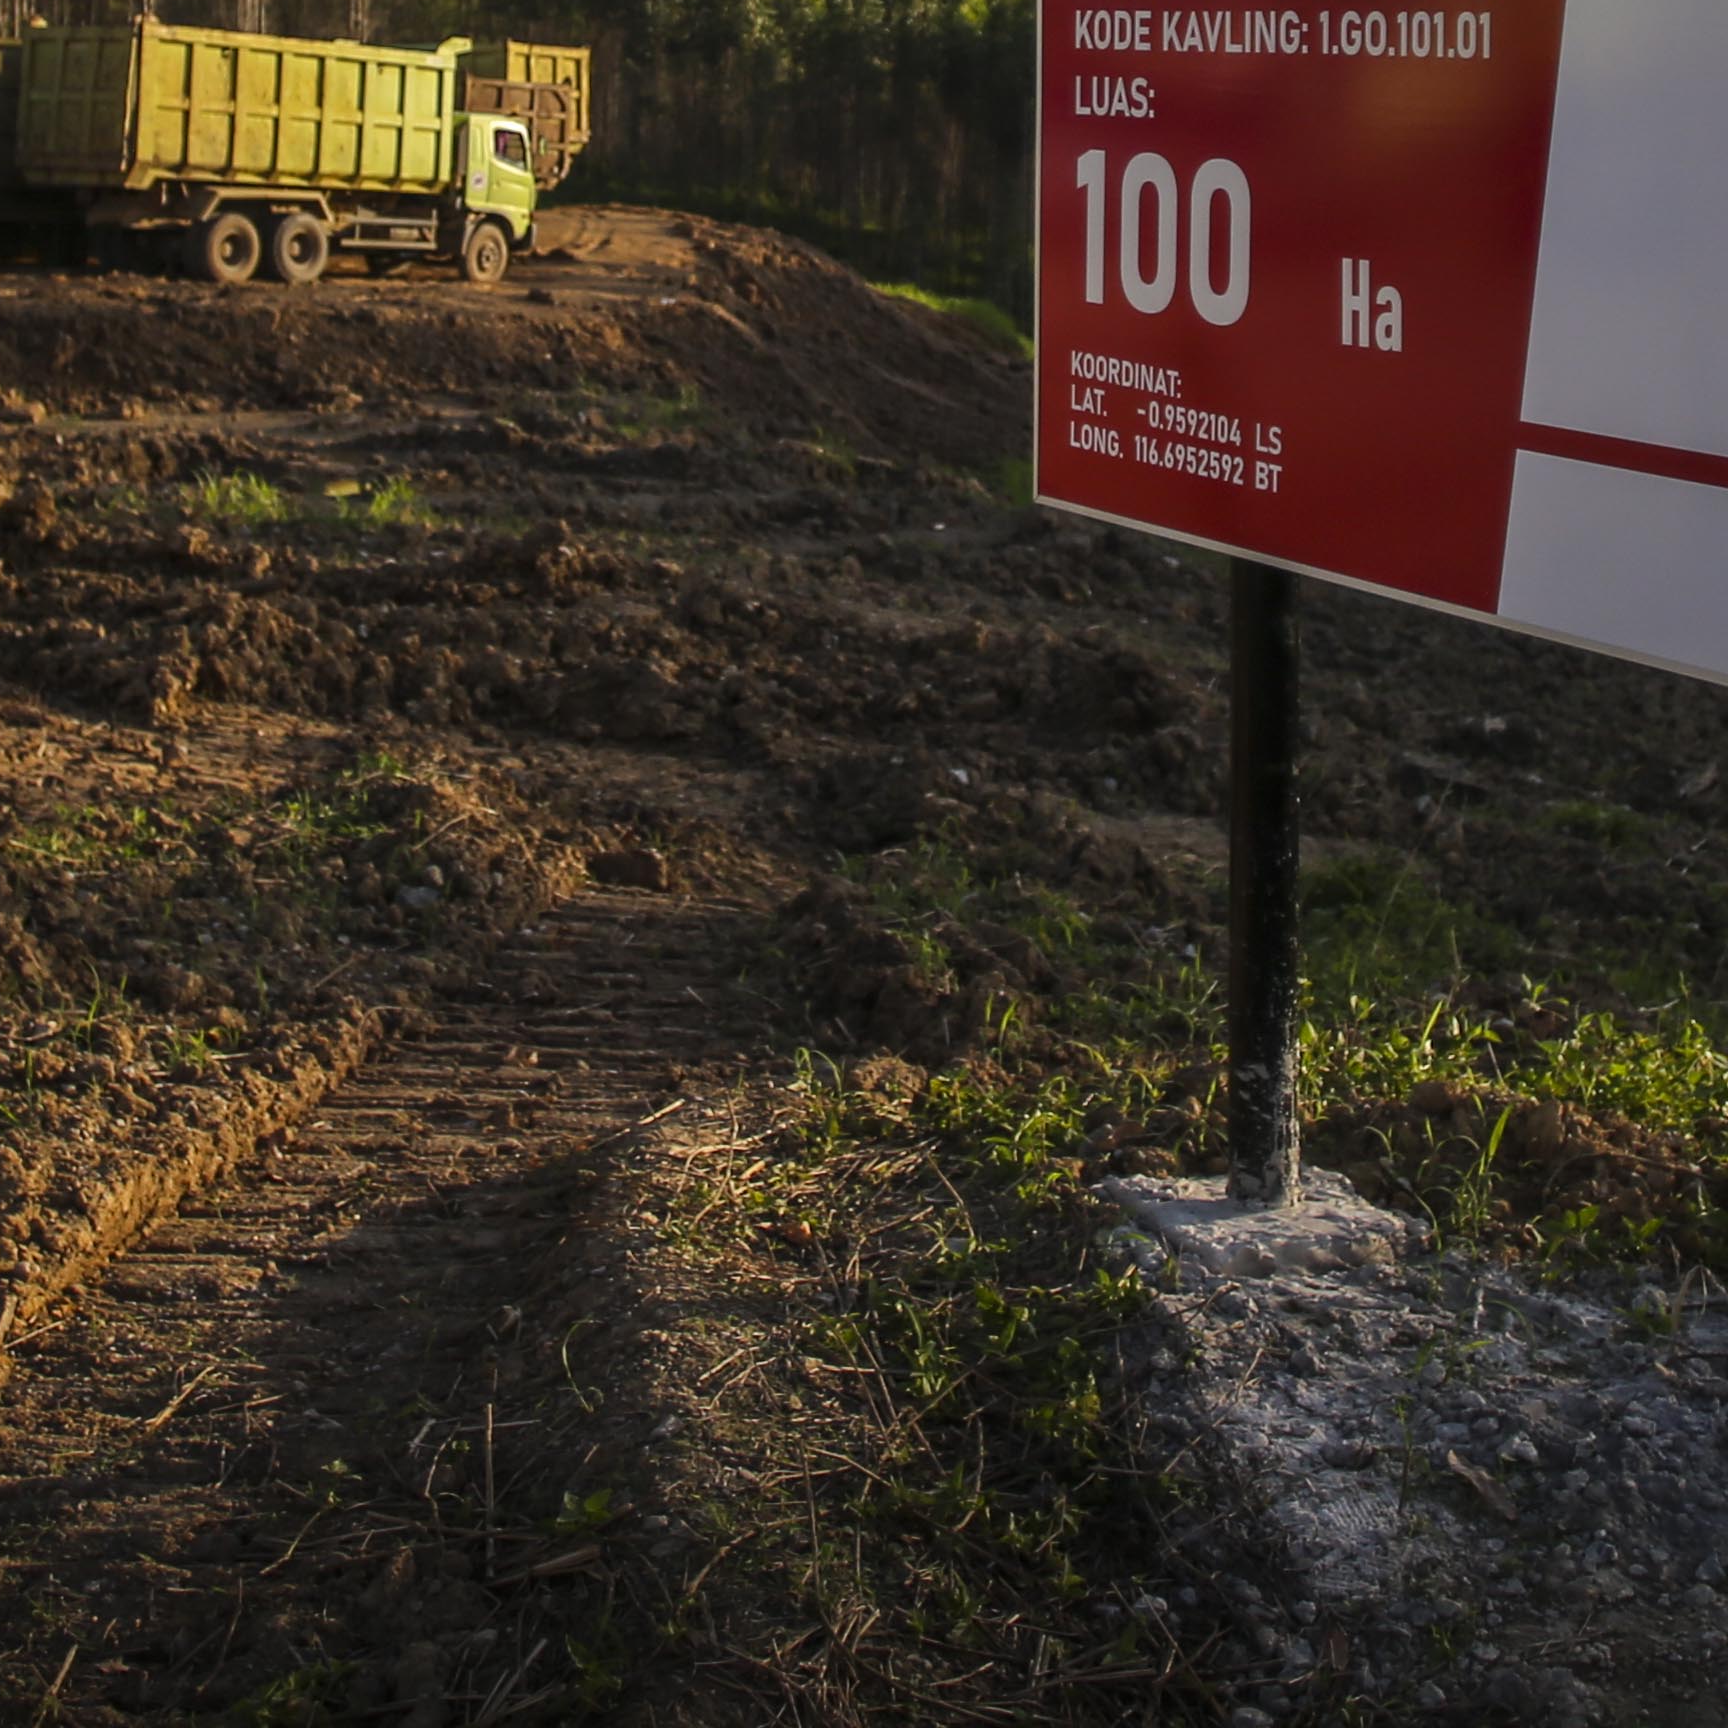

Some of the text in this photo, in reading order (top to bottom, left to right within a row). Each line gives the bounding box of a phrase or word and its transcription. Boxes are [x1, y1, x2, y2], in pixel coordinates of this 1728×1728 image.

[1075, 10, 1151, 50] KODE
[1162, 10, 1309, 54] KAVLING:
[1075, 76, 1155, 118] LUAS:
[1077, 148, 1403, 352] 100 Ha
[1071, 350, 1182, 398] KOORDINAT:
[1071, 384, 1282, 455] LAT. -0.9592104 LS
[1070, 421, 1282, 493] LONG. 116.6952592 BT
